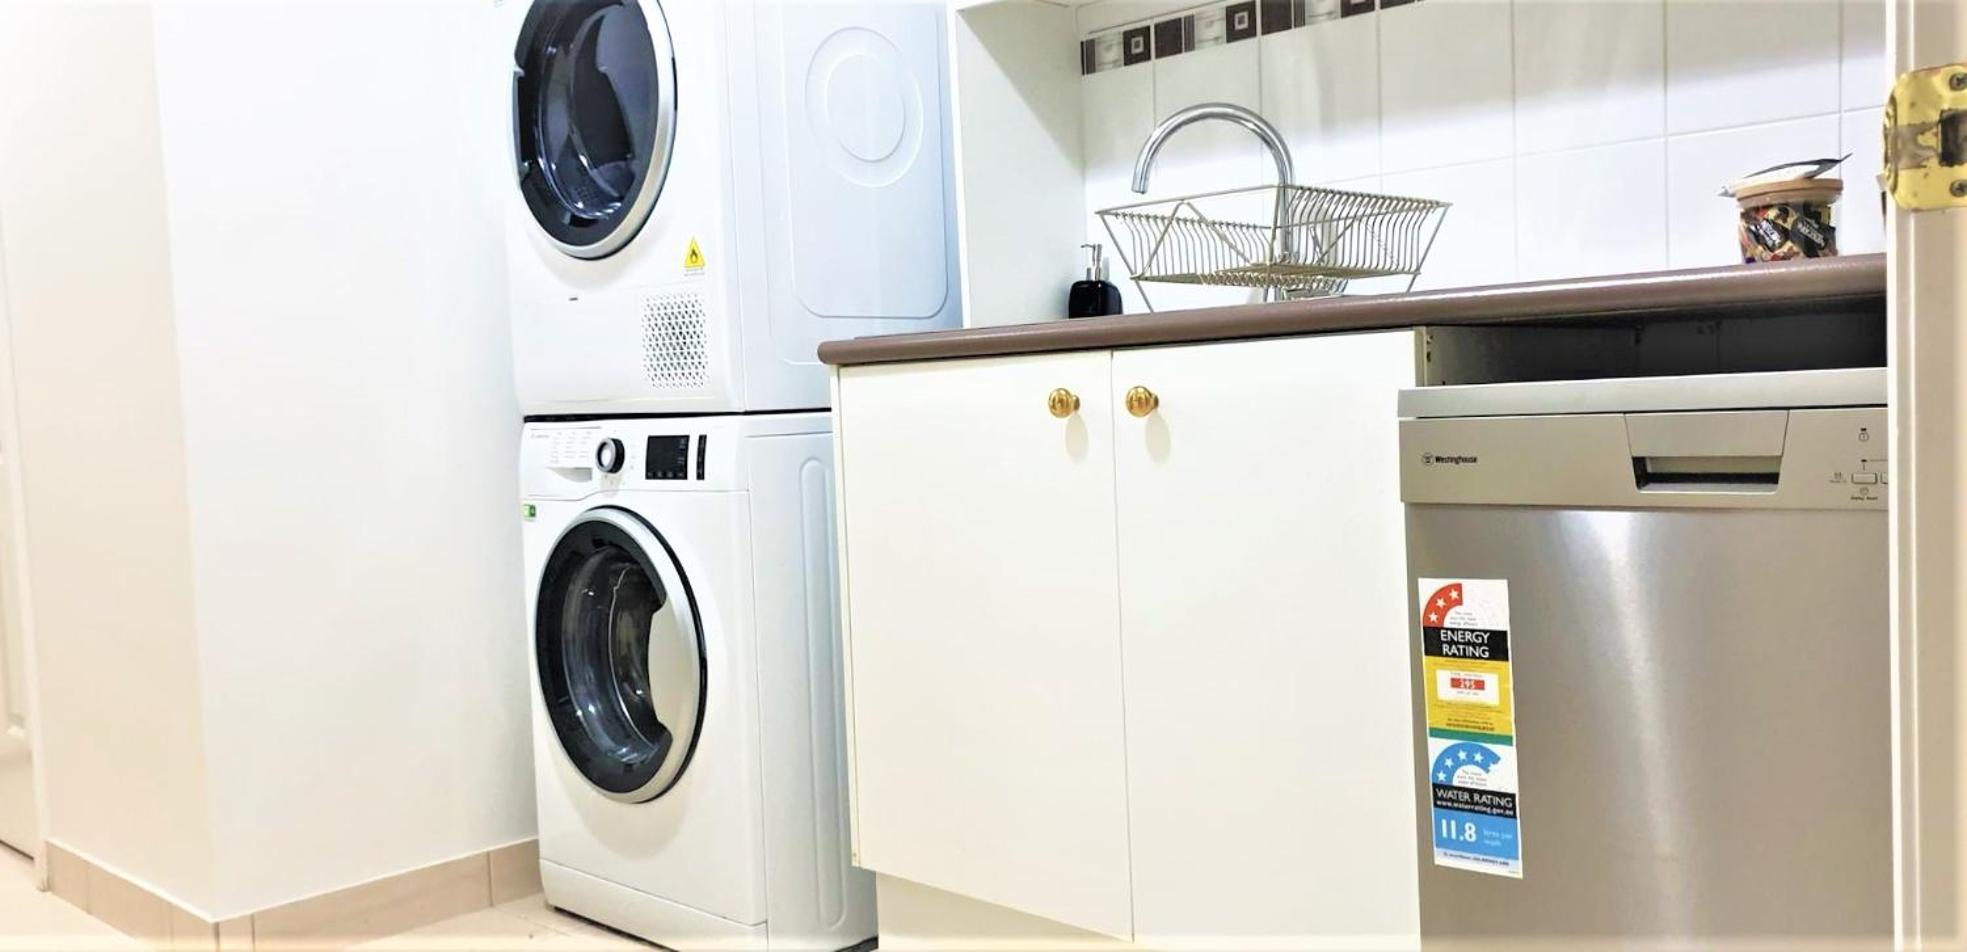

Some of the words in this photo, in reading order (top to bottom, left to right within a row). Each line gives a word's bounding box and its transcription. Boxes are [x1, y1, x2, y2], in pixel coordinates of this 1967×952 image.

[1440, 630, 1490, 643] ENERGY
[1442, 645, 1489, 658] RATING
[1435, 788, 1471, 802] WATER
[1473, 793, 1513, 808] RATING
[1441, 819, 1477, 843] 11.8
